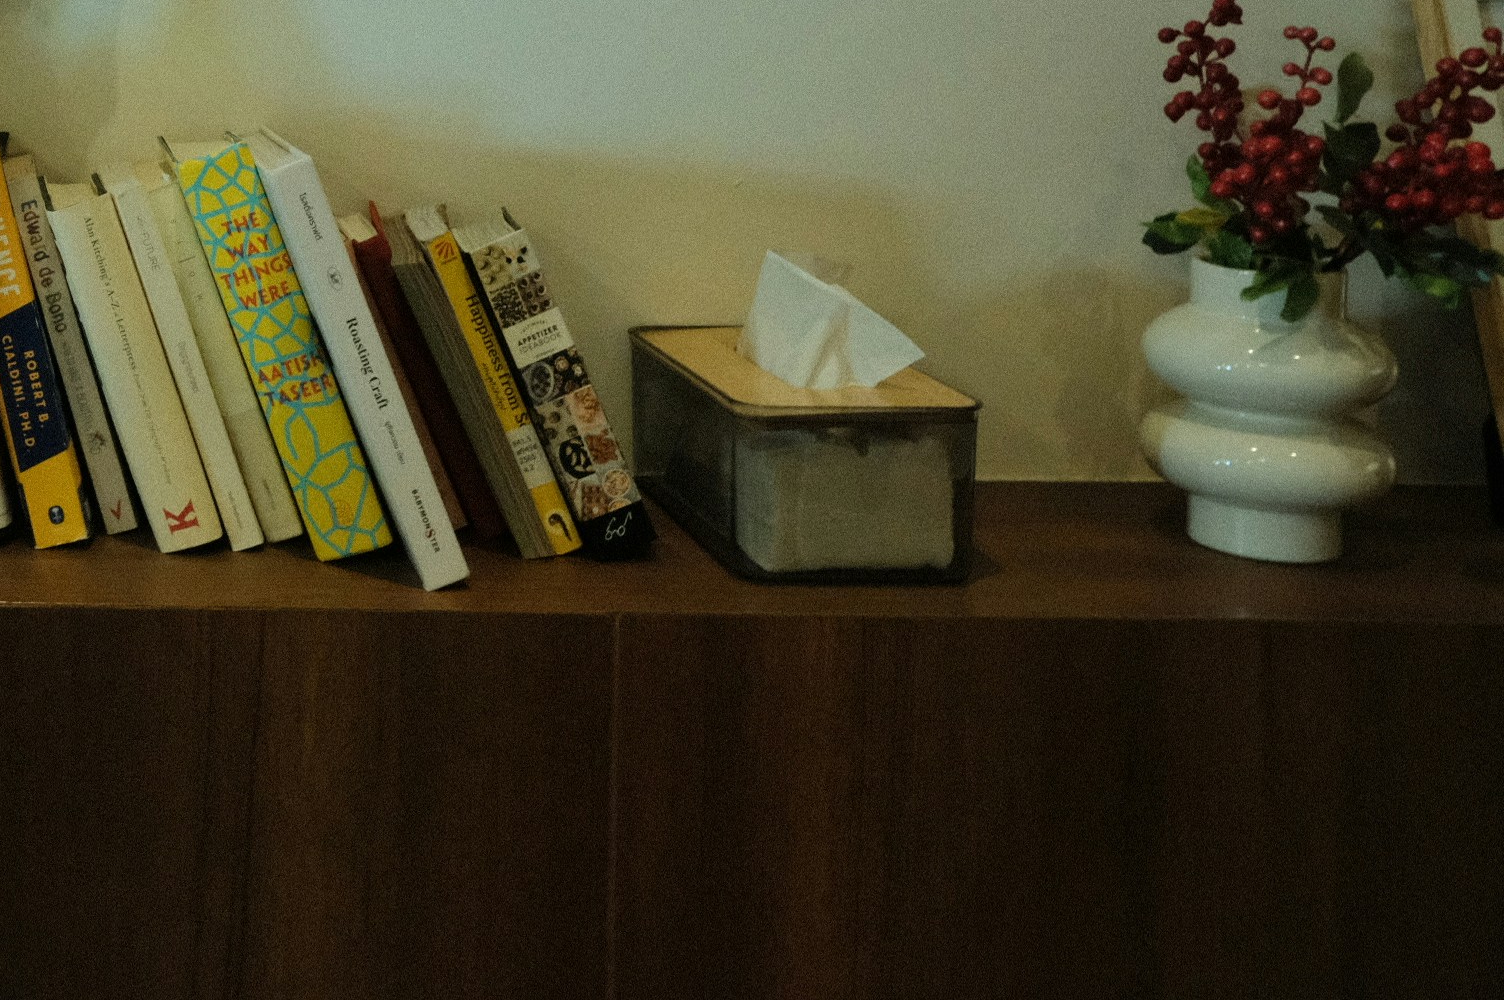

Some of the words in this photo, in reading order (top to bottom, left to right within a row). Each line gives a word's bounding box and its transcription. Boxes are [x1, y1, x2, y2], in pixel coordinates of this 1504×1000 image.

[21, 199, 50, 262] Edward
[221, 211, 261, 236] THE
[225, 233, 269, 263] WAY
[38, 266, 55, 288] de
[220, 251, 295, 290] THINGS
[45, 291, 68, 333] Bono
[84, 217, 95, 238] Alan
[91, 238, 112, 287] Kitching's
[115, 317, 137, 371] Letterpress
[239, 280, 291, 310] WERE
[465, 295, 504, 373] Happiness
[498, 371, 520, 411] from
[517, 324, 559, 347] APPETIZER
[347, 317, 374, 376] Roasting
[368, 375, 389, 410] Craft
[22, 349, 47, 409] ROBERT
[37, 411, 50, 430] B.
[263, 372, 336, 407] TASEER
[163, 499, 199, 535] K
[411, 488, 441, 553] BABYMONSTER
